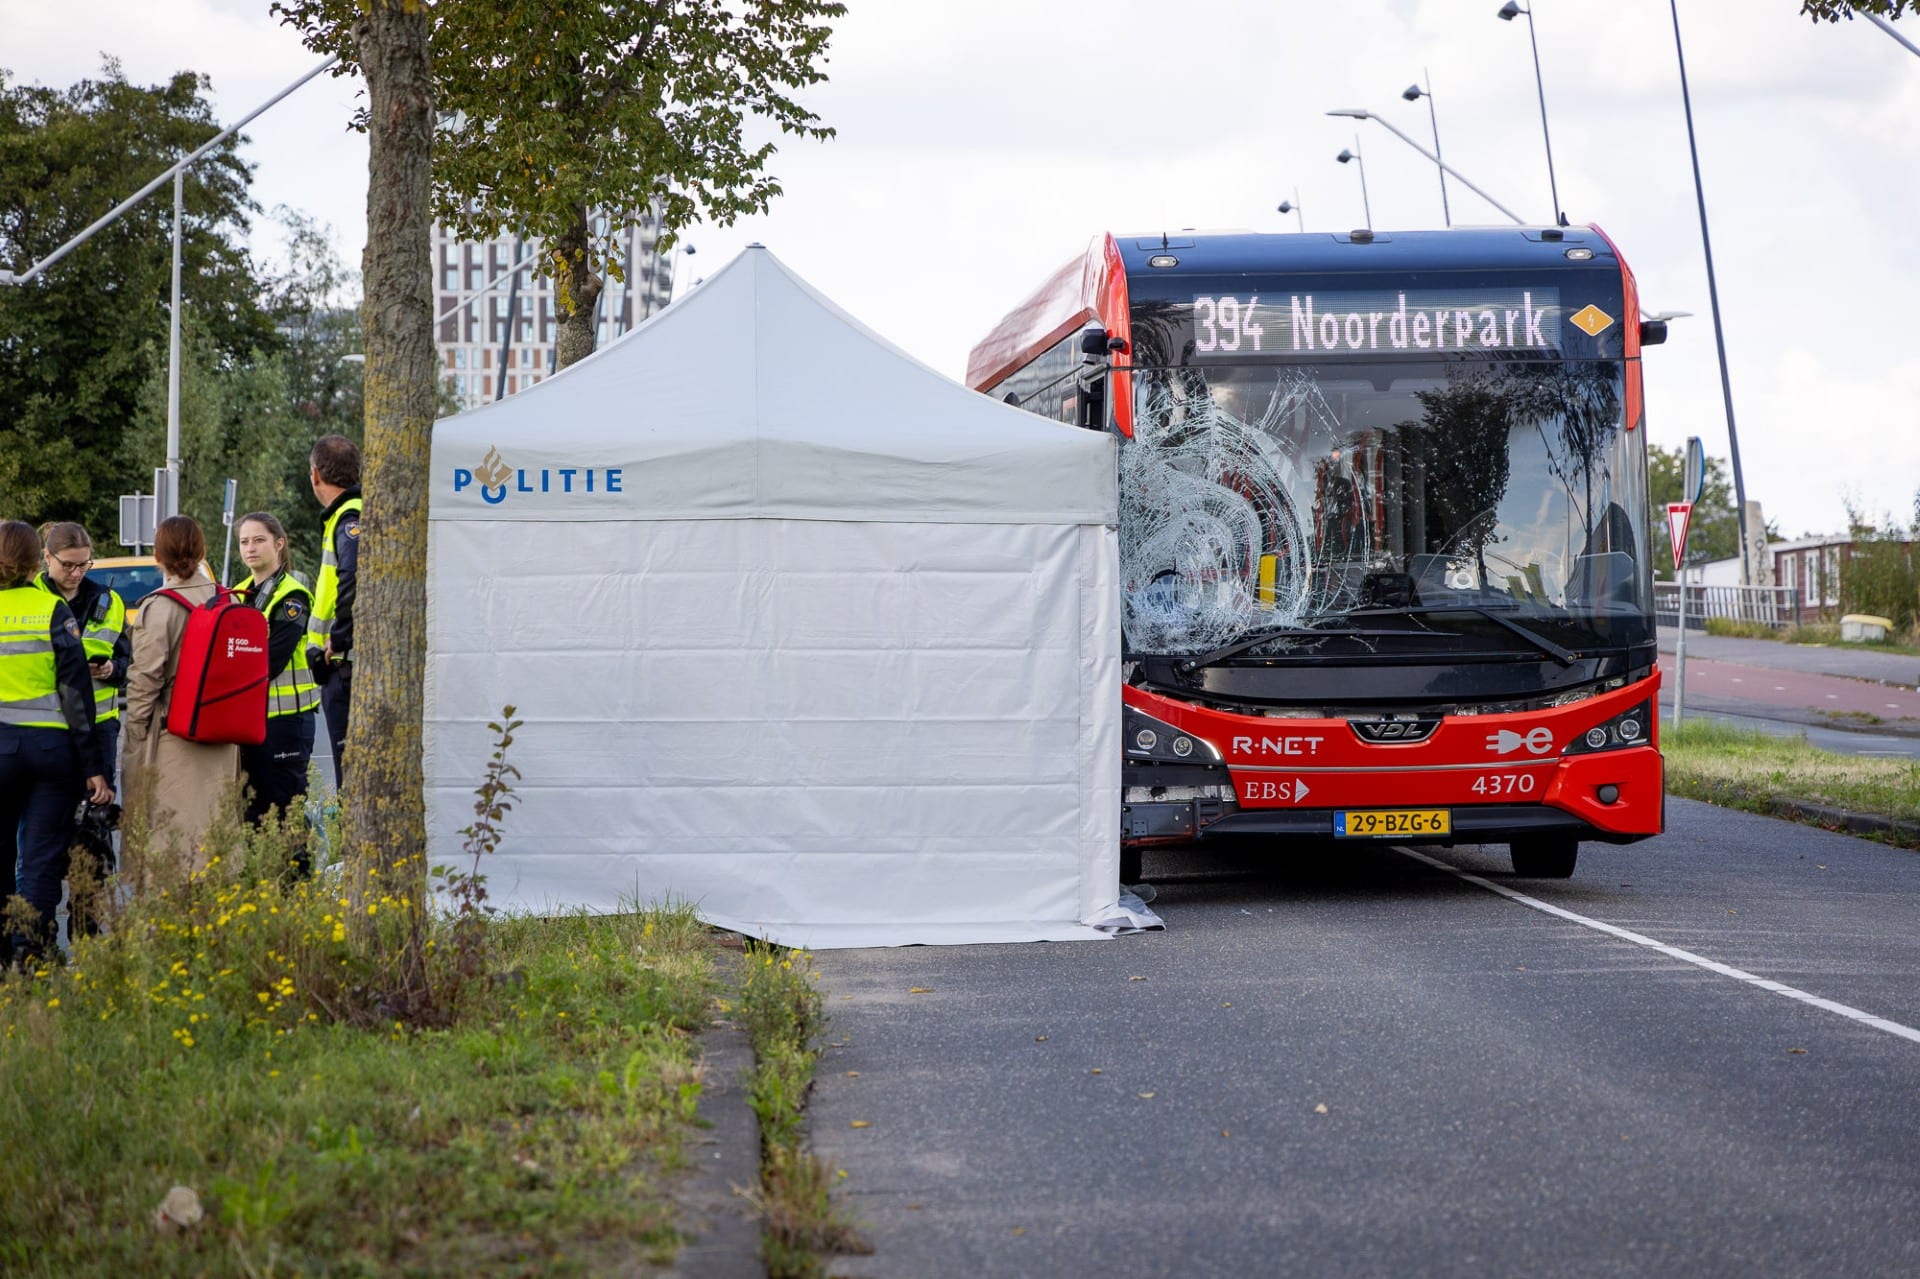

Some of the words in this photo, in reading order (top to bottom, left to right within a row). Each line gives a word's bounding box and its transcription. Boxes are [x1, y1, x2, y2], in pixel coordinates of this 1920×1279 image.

[1194, 295, 1263, 352] 394
[1290, 291, 1546, 351] Noorderpark
[454, 469, 623, 504] POLITIE
[1365, 723, 1423, 737] VDL
[1244, 781, 1291, 799] EBS
[1471, 773, 1535, 795] 4370
[1352, 813, 1442, 832] 29-BZG-6
